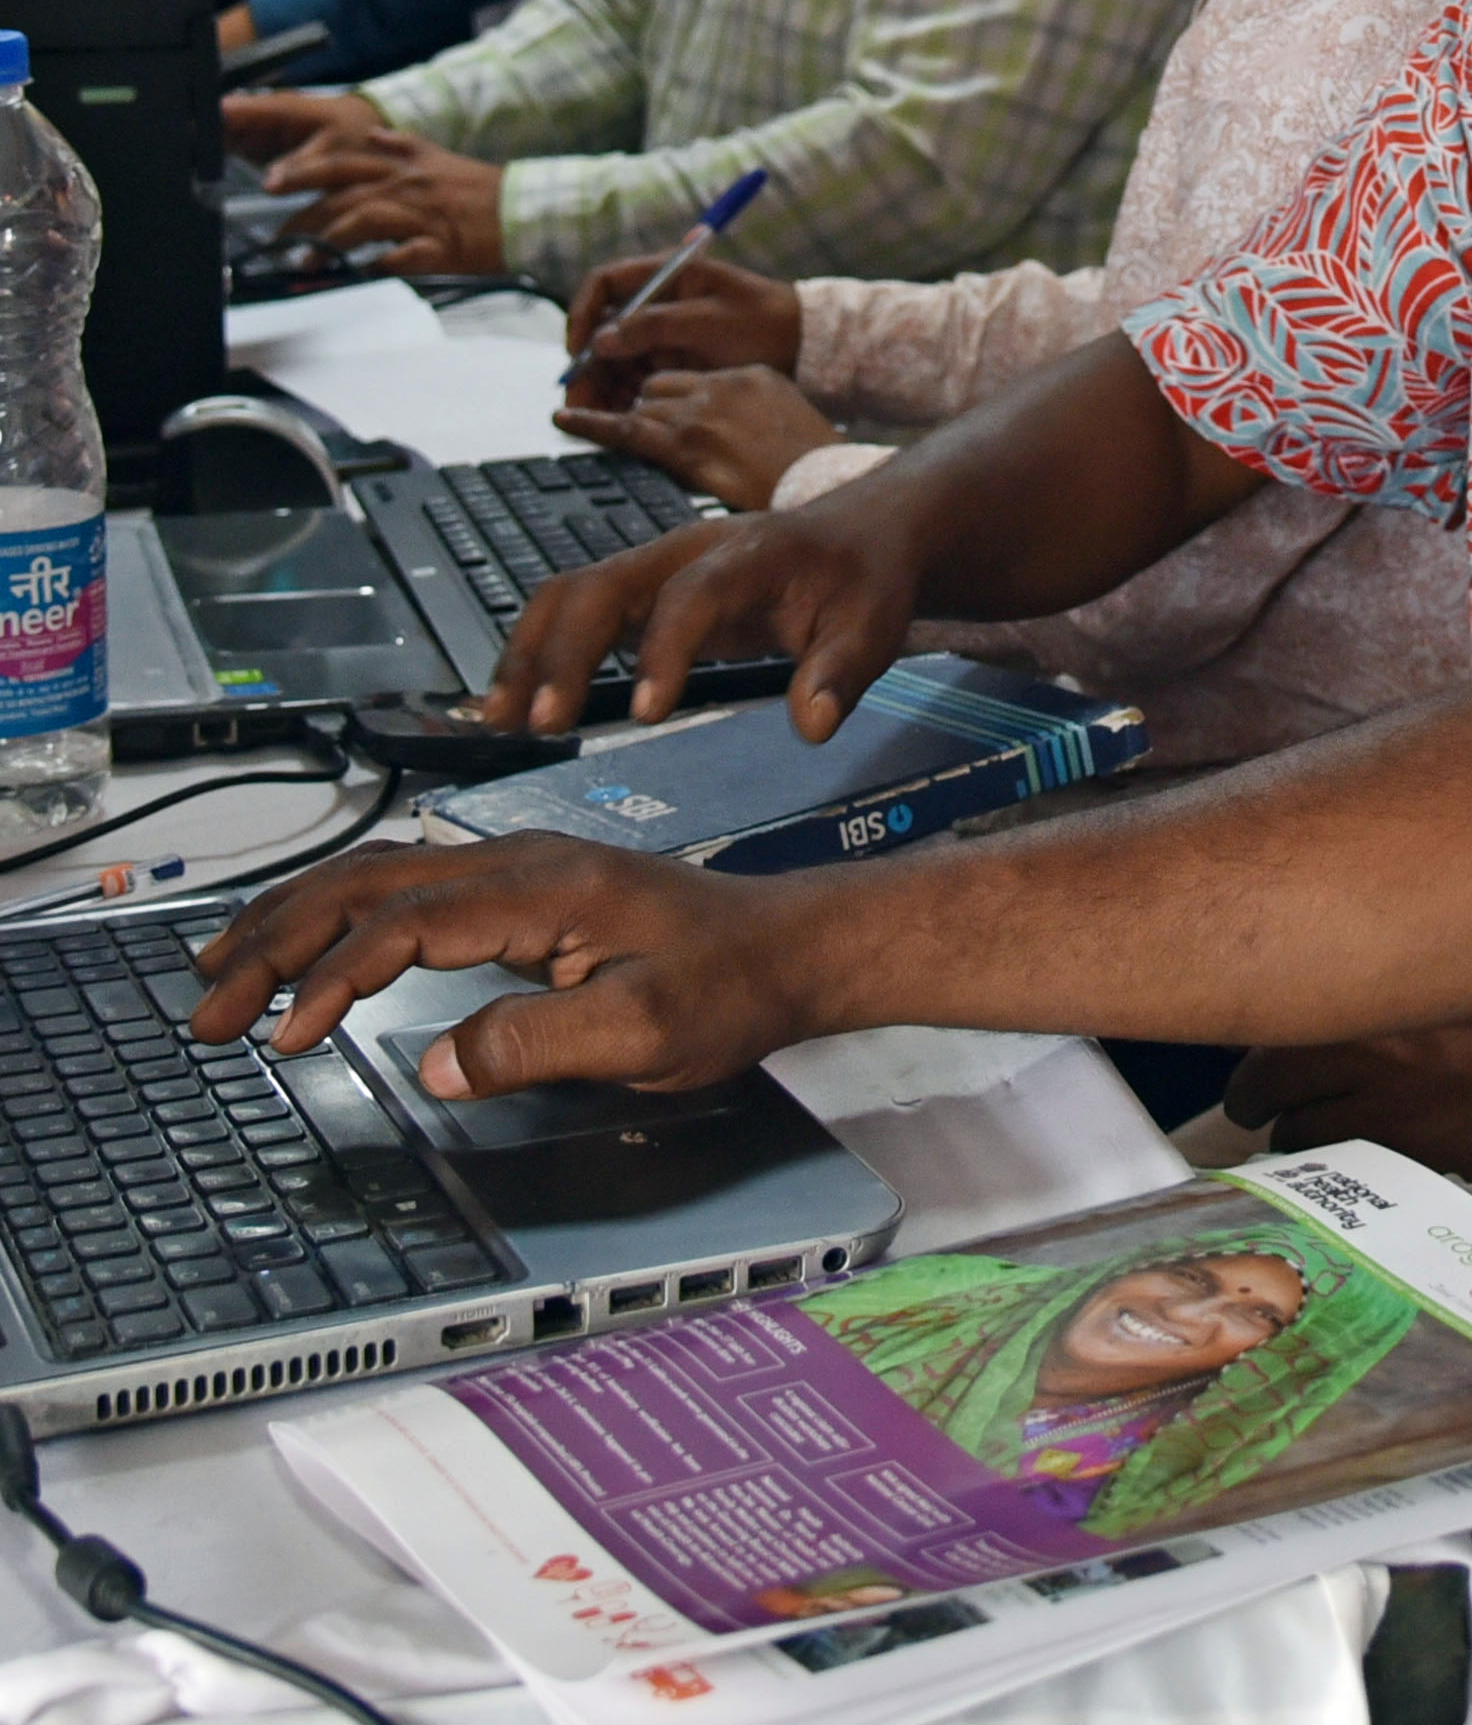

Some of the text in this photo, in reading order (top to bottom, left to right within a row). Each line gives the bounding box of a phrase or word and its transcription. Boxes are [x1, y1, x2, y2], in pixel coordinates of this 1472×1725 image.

[9, 555, 72, 606] नीर
[605, 794, 679, 823] SBI
[838, 810, 887, 851] SBI
[1285, 1181, 1367, 1230] authority
[1304, 1176, 1360, 1206] health
[1318, 1171, 1399, 1210] national
